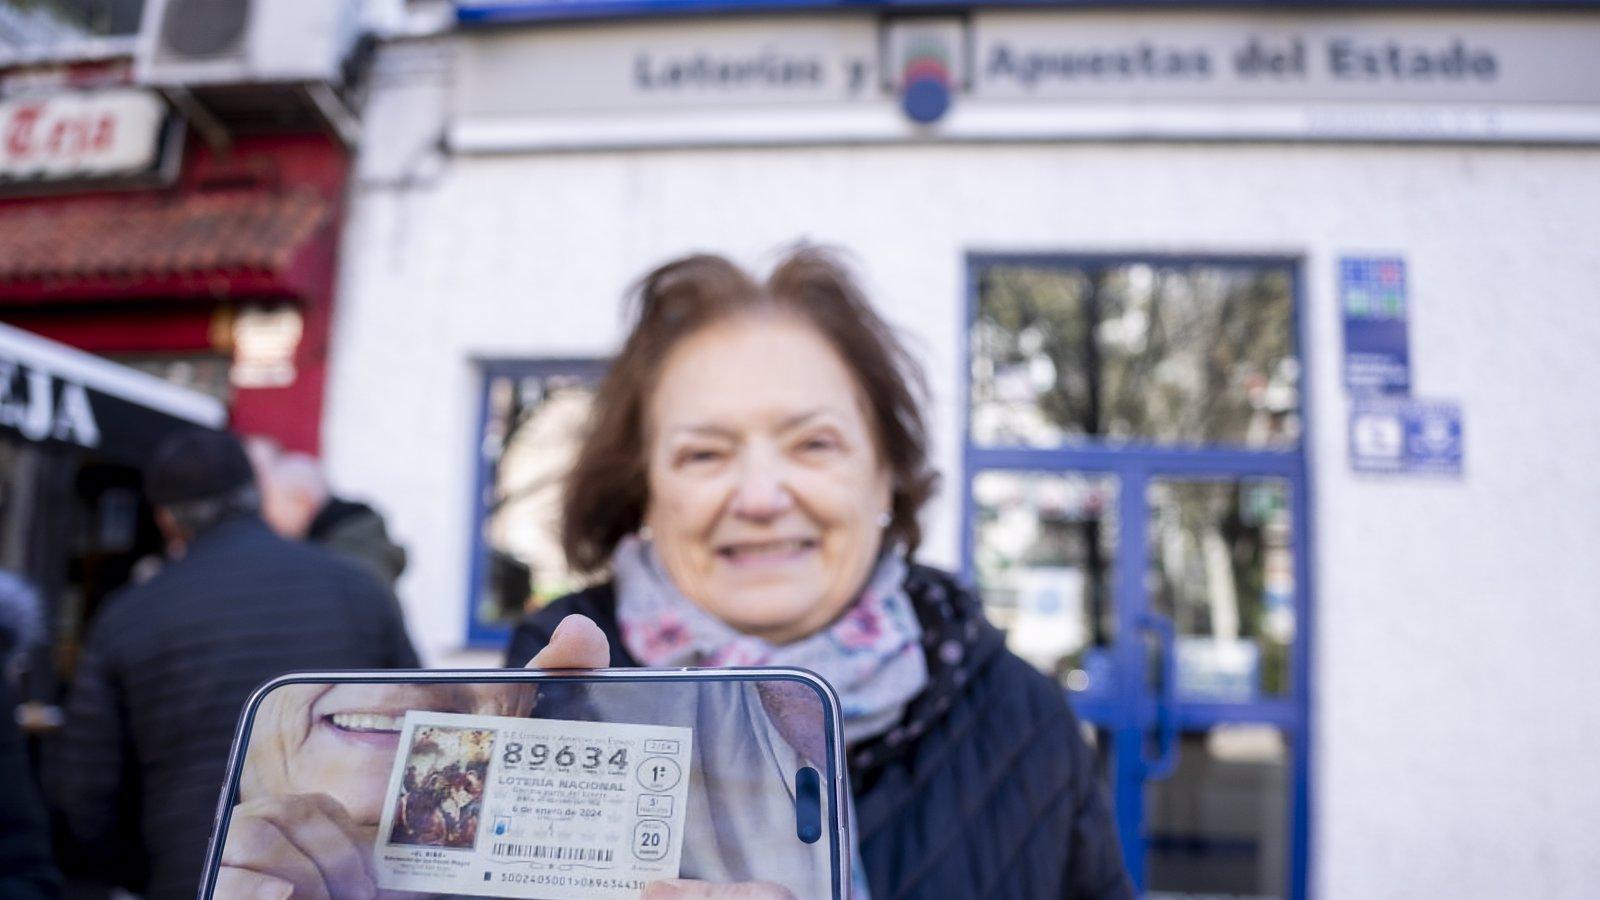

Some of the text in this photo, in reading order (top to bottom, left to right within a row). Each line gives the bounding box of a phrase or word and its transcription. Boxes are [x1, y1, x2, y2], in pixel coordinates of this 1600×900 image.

[634, 37, 1498, 90] Loterías y Apuestas del Estado
[503, 742, 628, 770] 89634
[498, 776, 626, 792] LOTERÍA NACIONAL
[535, 807, 562, 815] enero
[580, 808, 602, 817] 2024
[641, 832, 661, 847] 20
